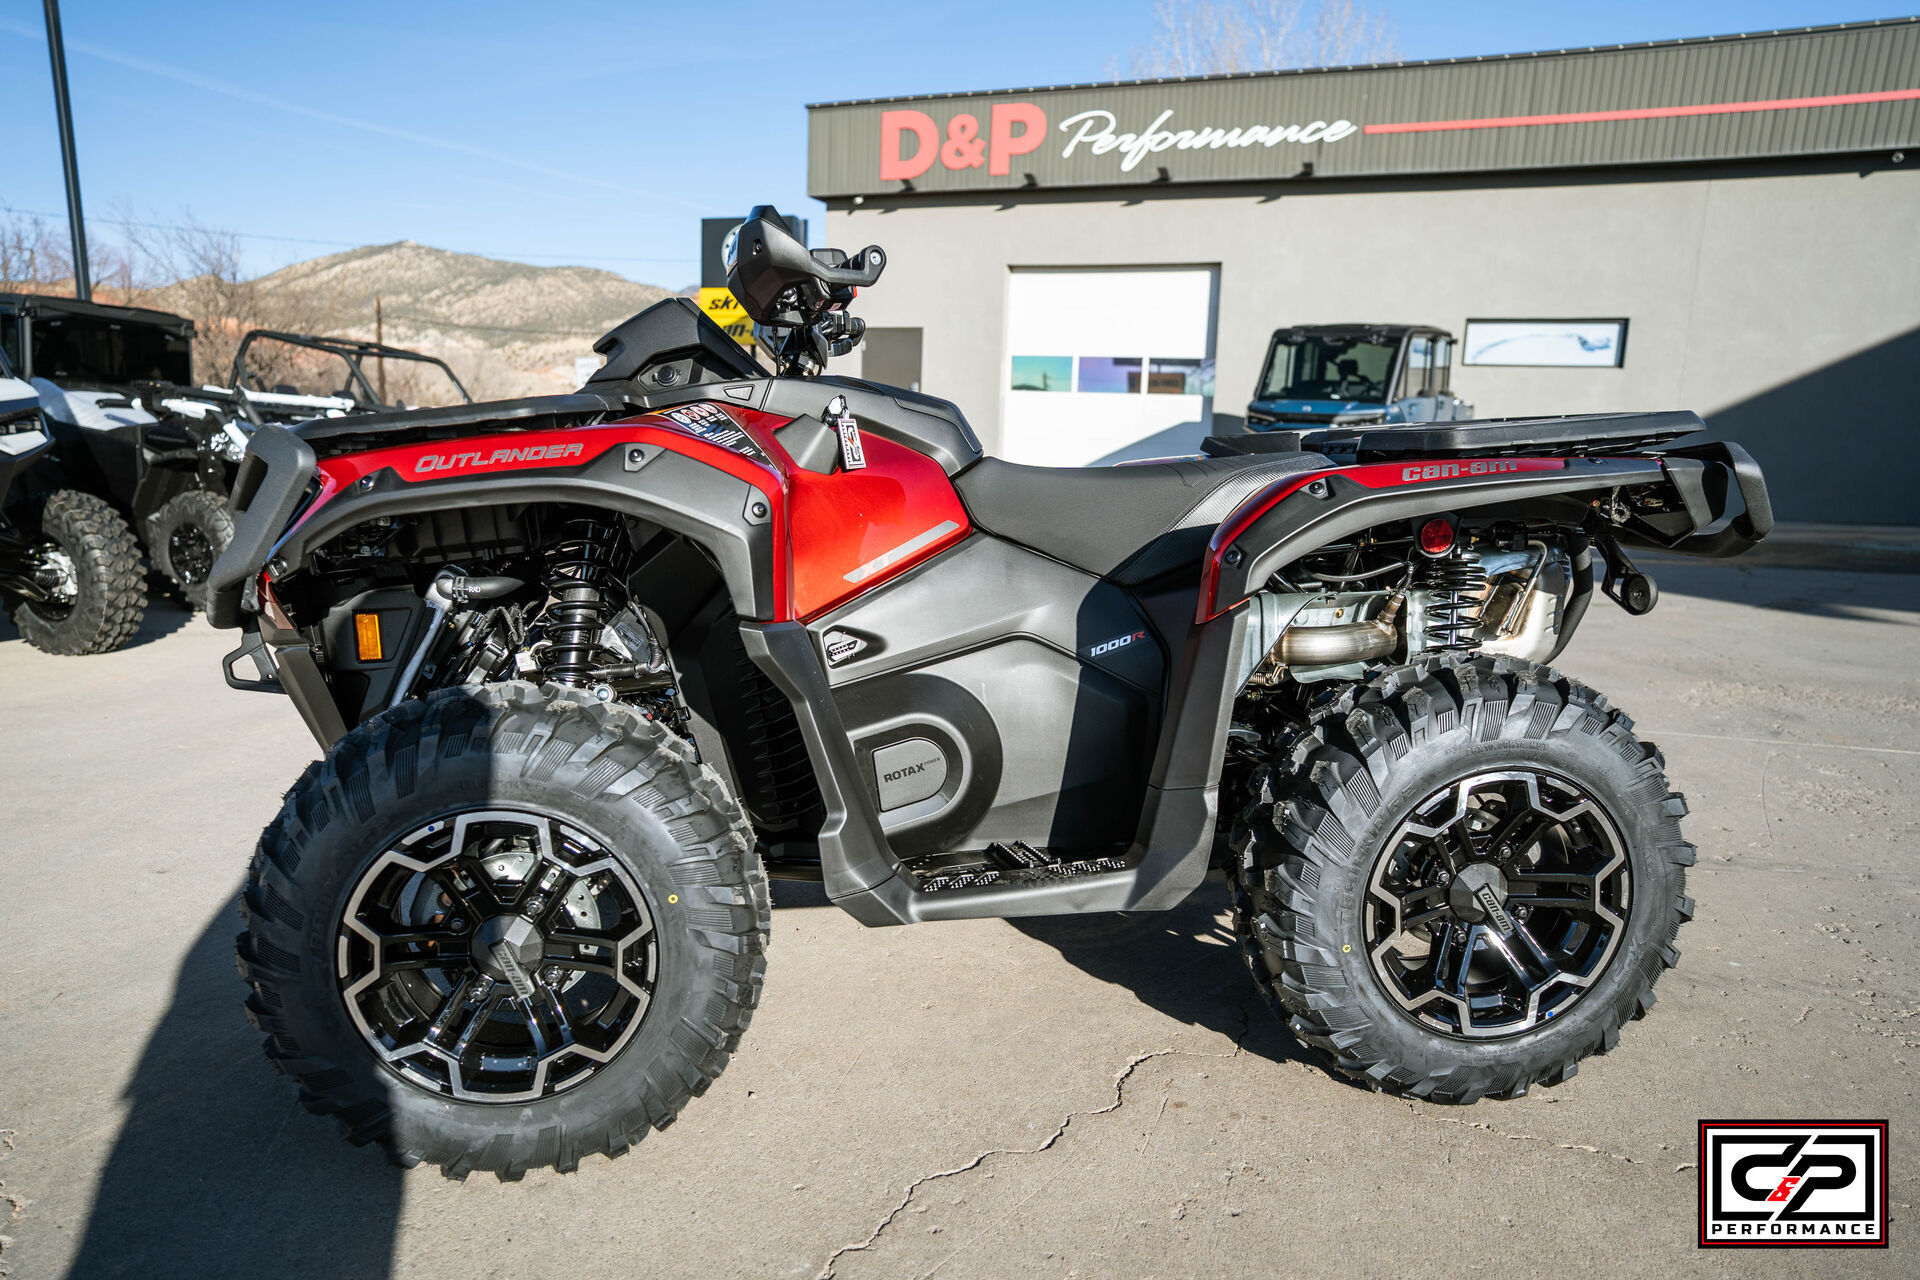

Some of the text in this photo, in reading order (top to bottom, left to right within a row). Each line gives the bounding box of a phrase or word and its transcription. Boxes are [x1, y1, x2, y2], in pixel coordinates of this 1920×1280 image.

[880, 102, 1359, 181] D&P Performance
[415, 443, 584, 473] OUTLANDER
[1402, 460, 1518, 481] can-am
[1090, 630, 1147, 657] 1000R
[883, 762, 925, 783] ROTAX
[1481, 892, 1512, 931] can-am
